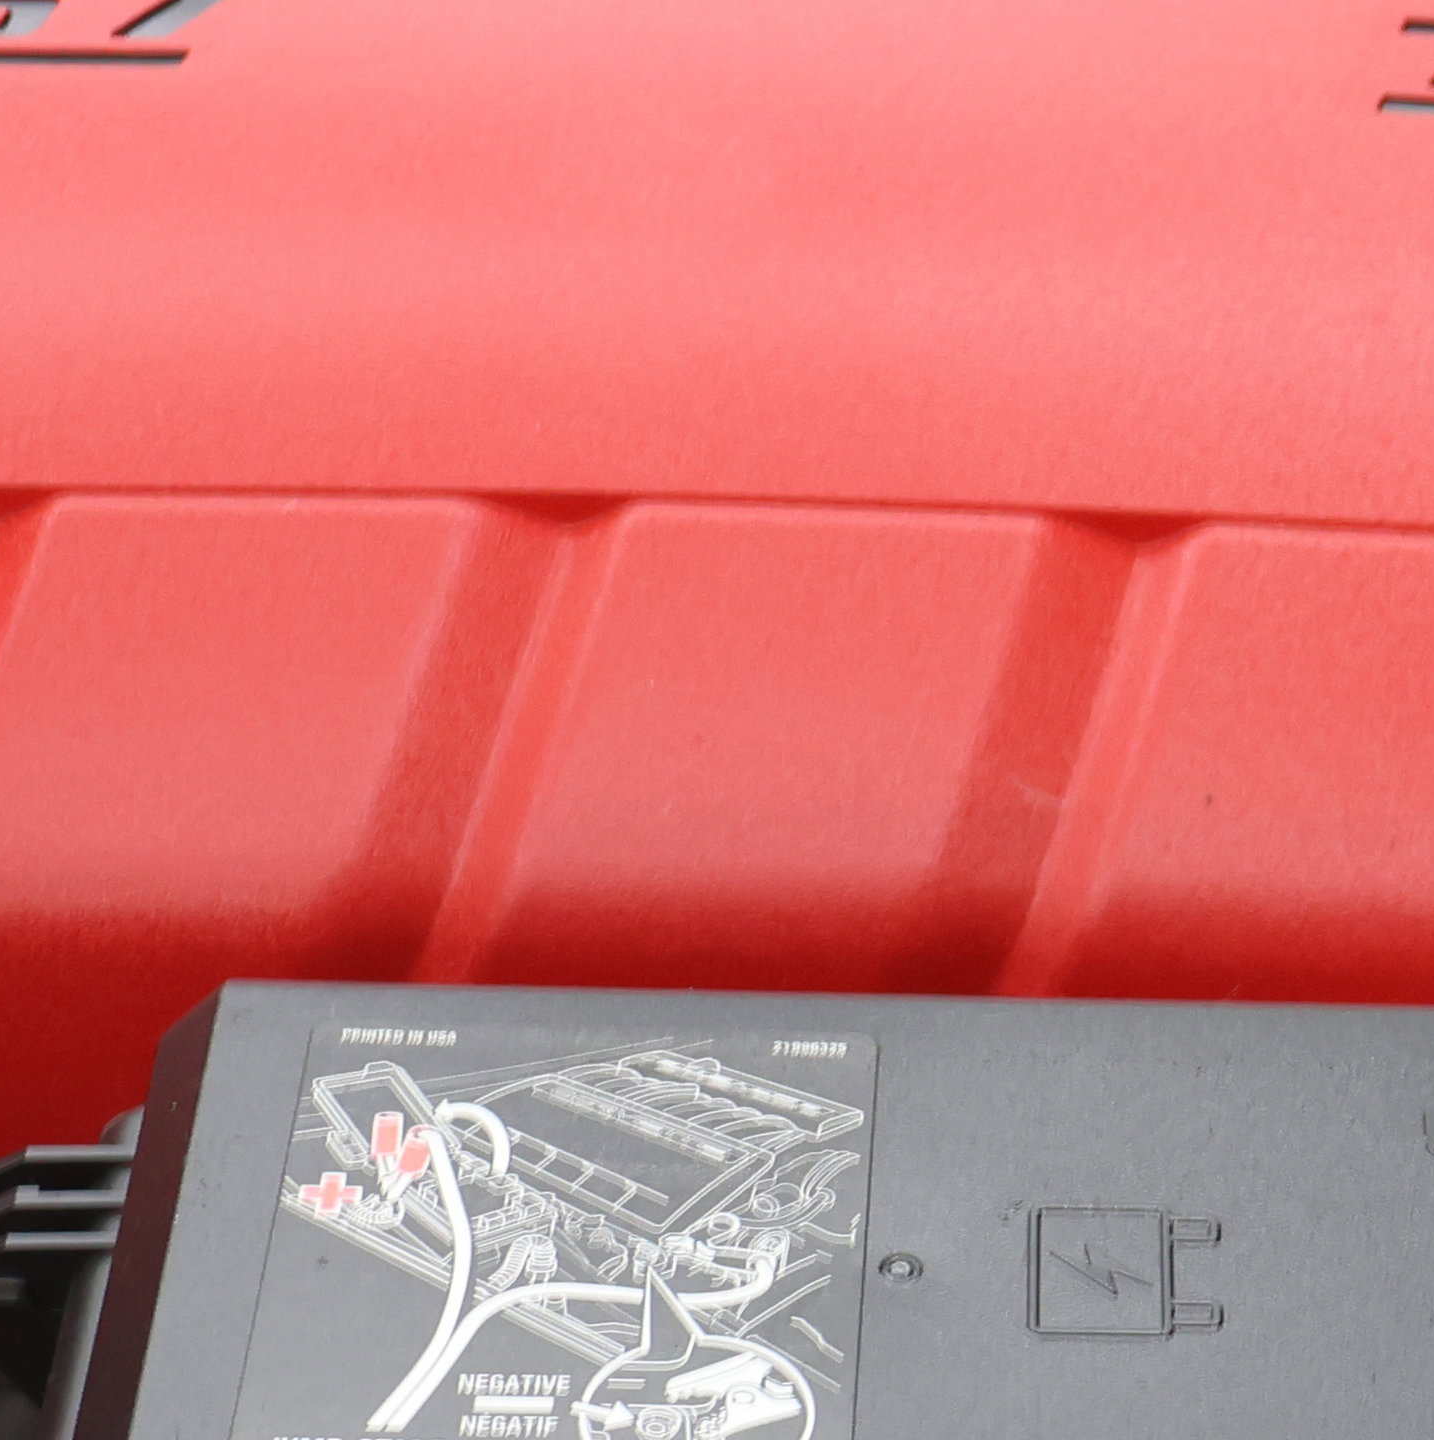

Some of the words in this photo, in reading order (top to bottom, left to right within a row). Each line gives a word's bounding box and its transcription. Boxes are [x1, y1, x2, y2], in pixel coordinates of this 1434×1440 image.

[340, 1027, 405, 1046] PRINTED
[406, 1028, 424, 1046] IN
[426, 1029, 458, 1048] USA
[457, 1373, 571, 1397] NEGATIVE
[458, 1412, 560, 1438] NÉGATIF
